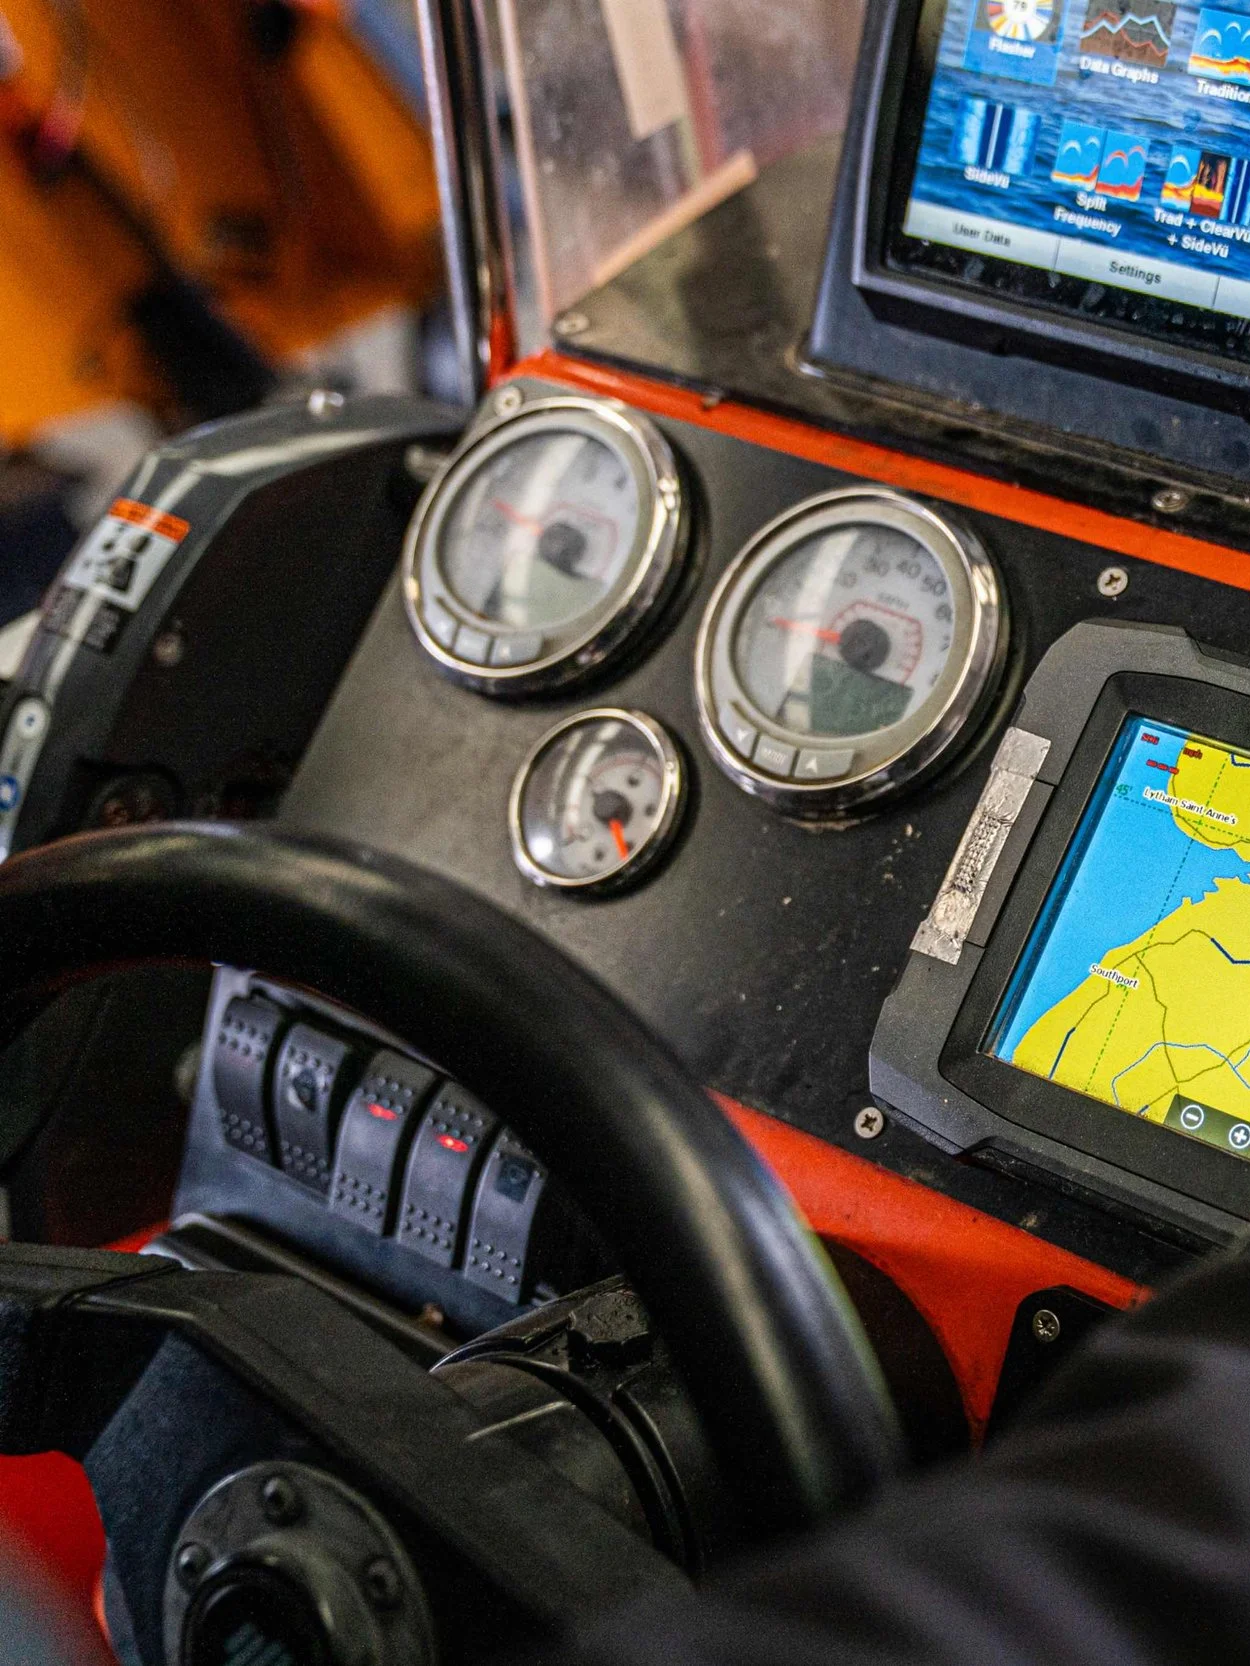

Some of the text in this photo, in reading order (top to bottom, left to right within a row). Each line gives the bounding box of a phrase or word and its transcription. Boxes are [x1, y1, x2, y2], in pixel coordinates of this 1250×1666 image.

[1079, 56, 1159, 84] Data Graphs
[1076, 191, 1107, 212] Split
[1054, 206, 1121, 237] Frequency
[1154, 207, 1182, 228] Trad
[953, 221, 1011, 248] User Data
[1109, 261, 1162, 285] Settings
[1144, 787, 1236, 825] Lytham Saint Anne's
[1091, 964, 1138, 988] Southport
